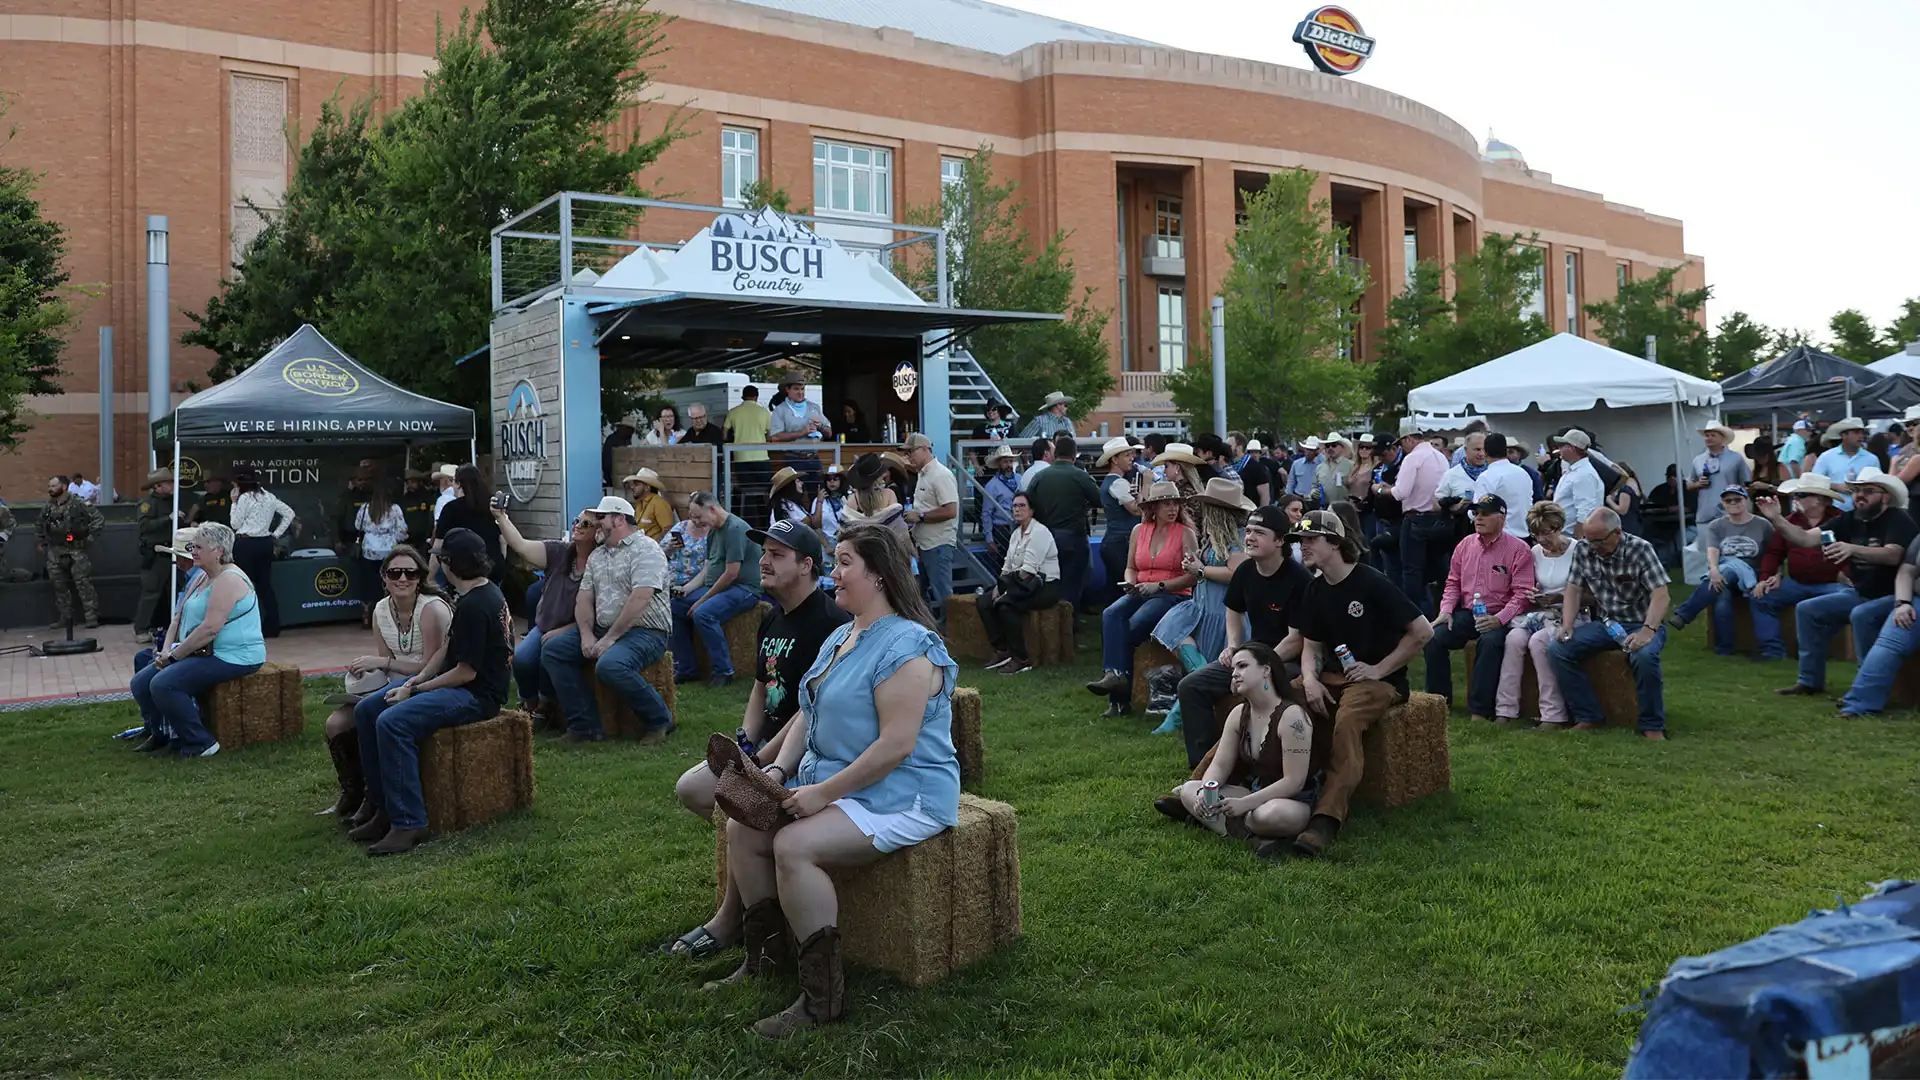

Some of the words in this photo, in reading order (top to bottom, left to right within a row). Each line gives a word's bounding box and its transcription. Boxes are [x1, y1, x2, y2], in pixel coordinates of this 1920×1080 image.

[1308, 25, 1369, 52] Dickies
[711, 239, 823, 279] BUSCH
[733, 271, 804, 296] Country
[892, 373, 917, 388] BUSCH
[223, 420, 275, 432] WE'RE
[283, 420, 343, 431] HIRING.
[346, 420, 393, 431] APPLY
[399, 420, 437, 431] NOW.
[501, 420, 547, 460] BUSCH
[268, 459, 302, 467] AGENT
[306, 458, 319, 466] OF
[510, 461, 537, 479] LIGHT
[254, 468, 320, 484] TION
